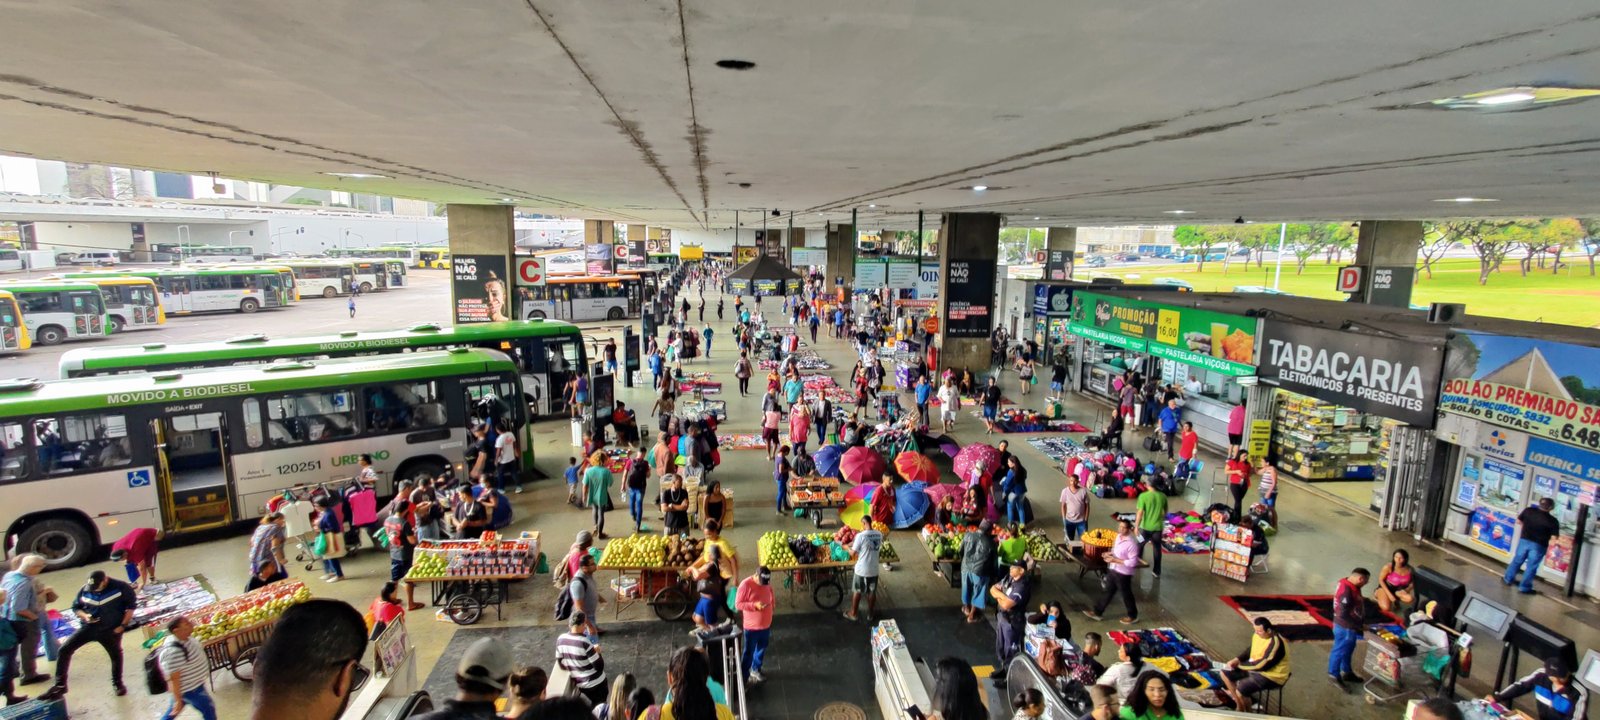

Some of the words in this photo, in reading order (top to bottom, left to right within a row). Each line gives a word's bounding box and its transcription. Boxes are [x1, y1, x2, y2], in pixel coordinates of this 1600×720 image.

[616, 246, 627, 258] C
[1037, 252, 1046, 261] D
[455, 264, 477, 274] NÃO
[520, 260, 541, 283] C
[950, 267, 969, 278] NÃO
[1342, 269, 1358, 288] D
[1112, 306, 1155, 325] PROMOÇÃO
[1083, 328, 1108, 341] PASTELARIA
[1109, 334, 1126, 345] VIÇOSA
[1158, 326, 1177, 338] 16,00
[320, 341, 355, 350] MOVIDO
[366, 338, 410, 347] BIODIESEL
[1165, 348, 1203, 364] PASTELARIA
[1204, 357, 1230, 372] VIÇOSA
[1269, 339, 1424, 399] TABACARIA
[107, 390, 166, 404] MOVIDO
[170, 390, 180, 398] A
[183, 383, 255, 398] BIODIESEL
[1279, 368, 1343, 393] ELETRÔNICOS
[1346, 384, 1354, 395] &
[1357, 386, 1423, 412] PRESENTES
[1444, 379, 1492, 399] BOLÃO
[1495, 385, 1578, 420] PREMIADO
[1549, 428, 1559, 439] R$
[1480, 443, 1515, 458] Loterias
[276, 460, 321, 475] 120251
[331, 450, 389, 467] URBNO
[1529, 451, 1582, 474] LOTÉRICA
